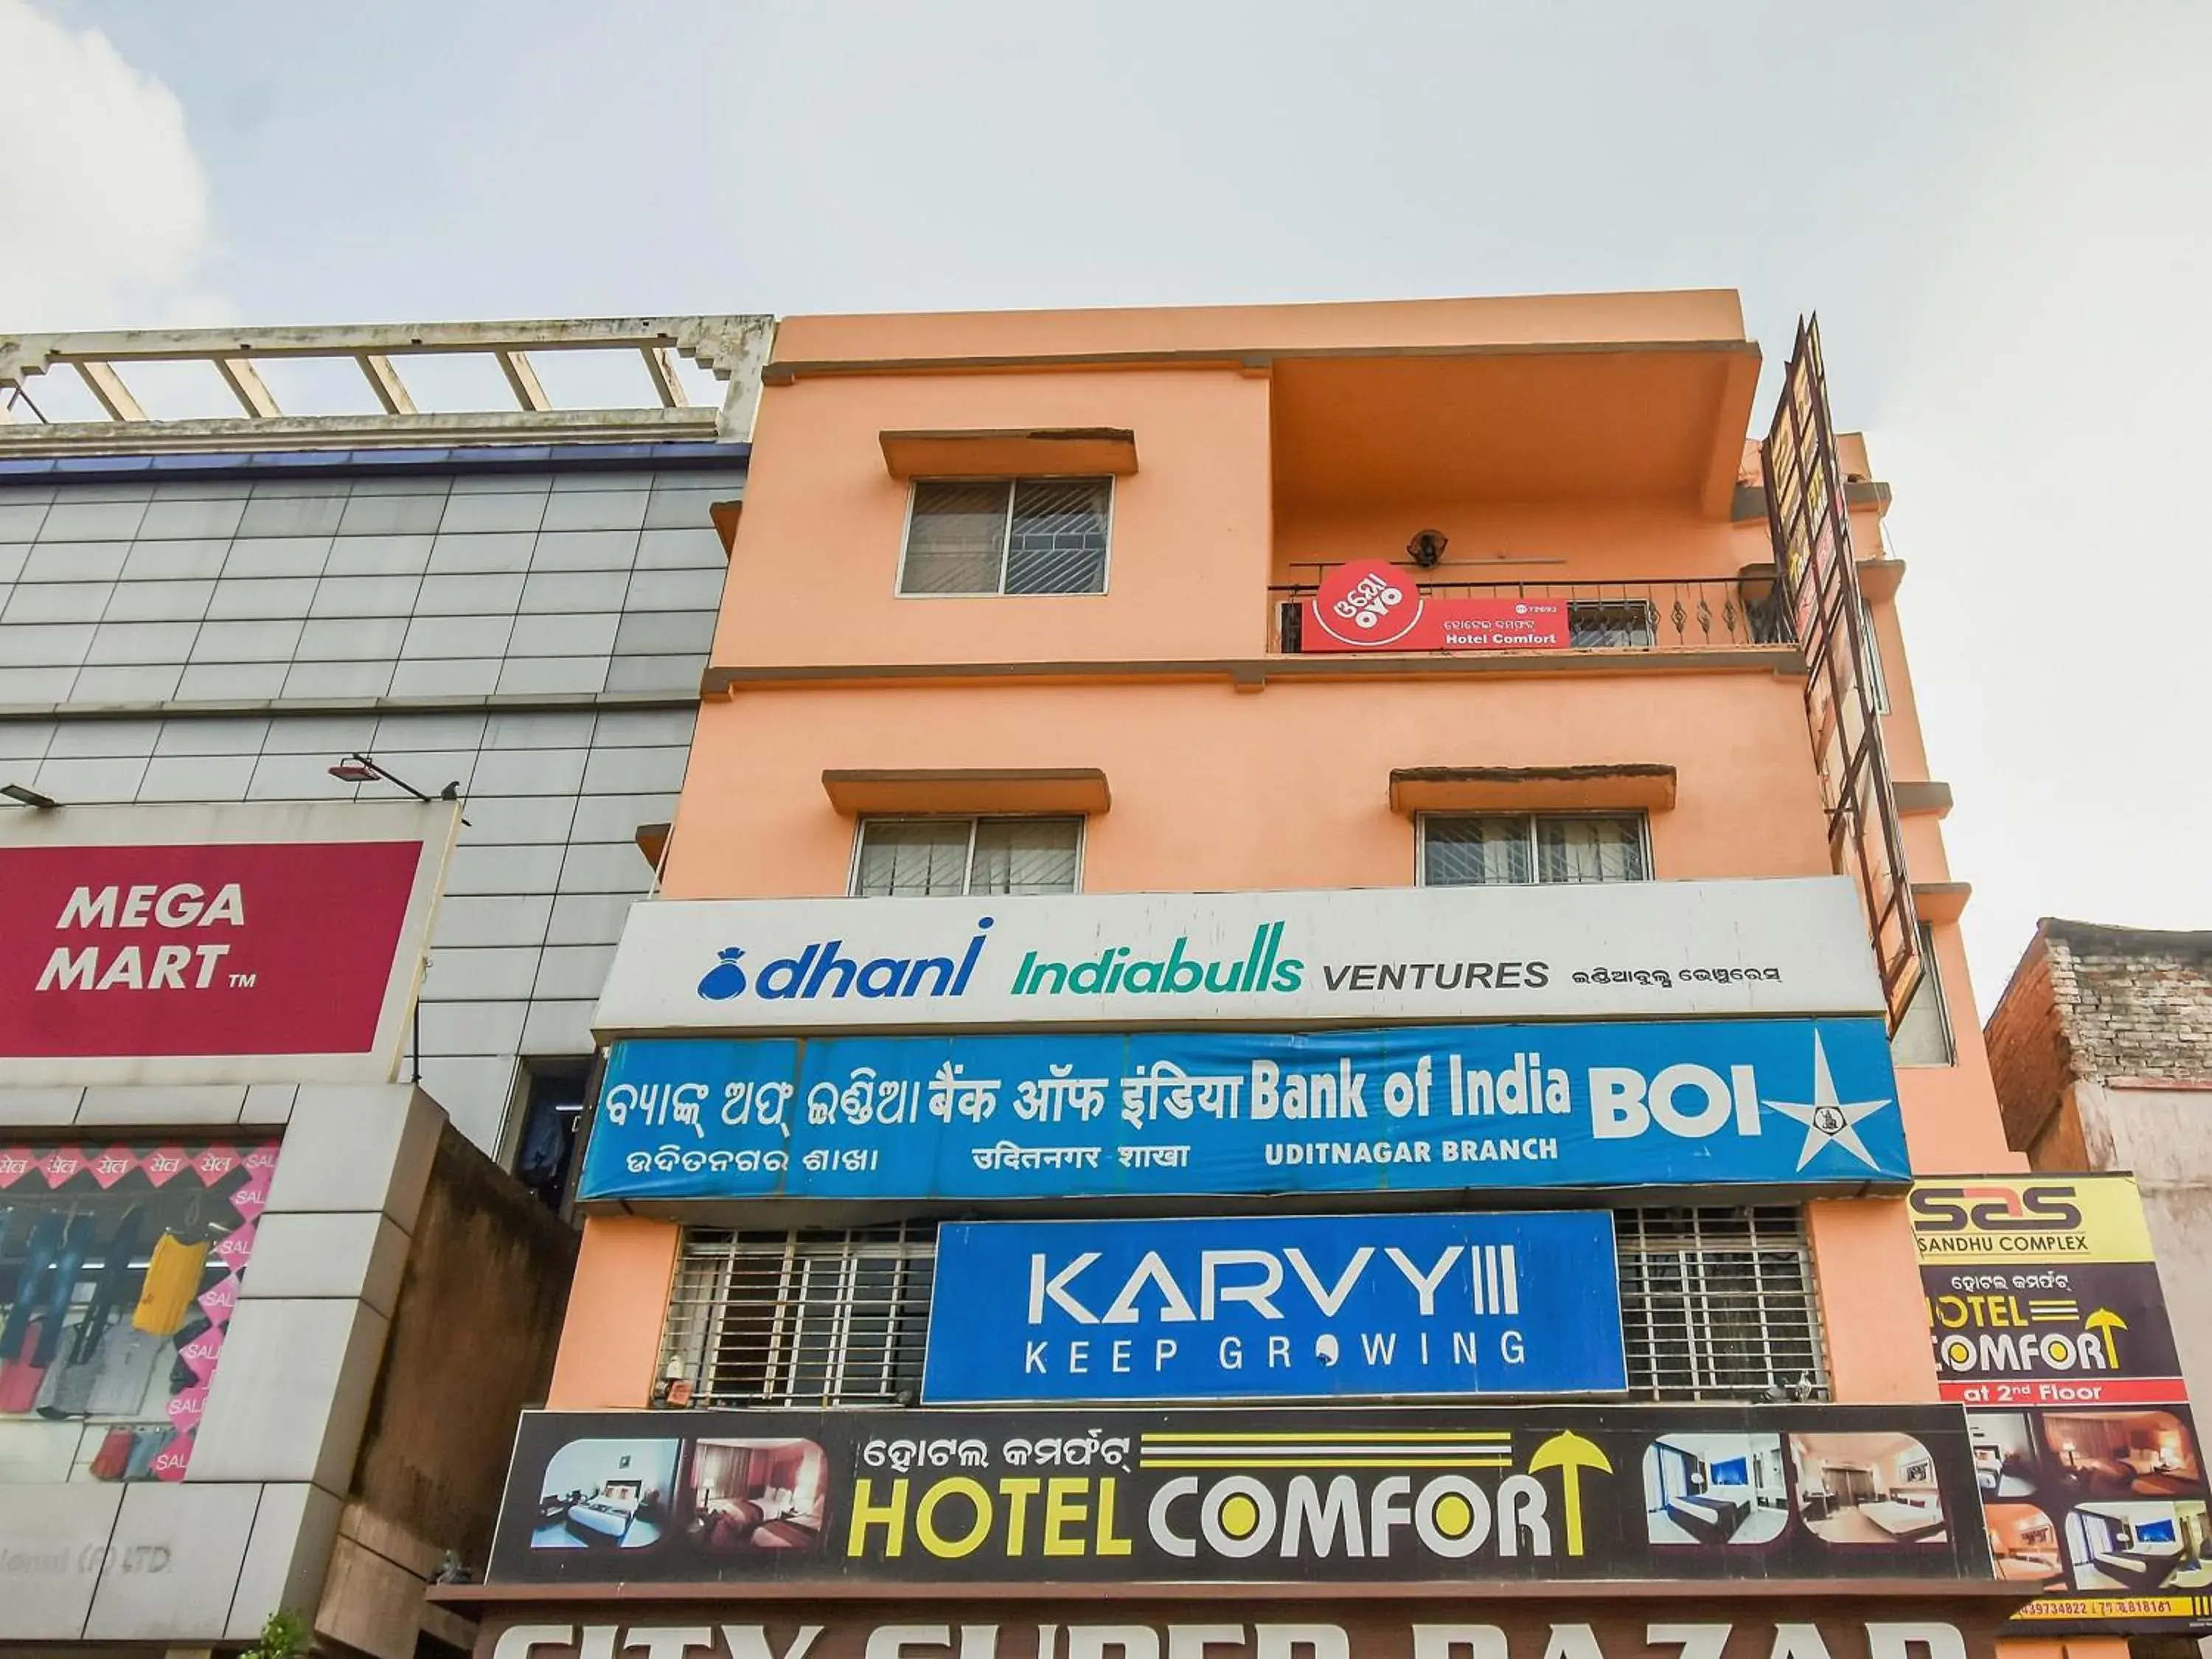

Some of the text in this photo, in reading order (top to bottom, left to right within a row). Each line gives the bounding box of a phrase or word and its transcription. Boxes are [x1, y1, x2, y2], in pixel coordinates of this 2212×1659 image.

[1355, 587, 1402, 628] OYO
[1446, 633, 1557, 644] Hotel Comfort
[55, 883, 245, 929] MEGA
[35, 944, 257, 991] MART TM
[1010, 920, 1304, 995] Indiabulls
[1322, 961, 1550, 992] VENTURES
[928, 1060, 1244, 1130] बैंक ऑफ इंडिया
[1250, 1051, 1573, 1120] Bank of India
[1588, 1063, 1764, 1141] BOI
[971, 1139, 1191, 1170] उदितनगर शाखा
[1265, 1137, 1559, 1167] UDITNAGAR BRANCH
[1918, 1235, 2088, 1253] SANDHU COMPLEX
[1024, 1330, 1526, 1374] KEEP GROWING
[1964, 1385, 1989, 1402] at
[2039, 1383, 2103, 1400] Floor
[846, 1476, 1133, 1559] HOTEL
